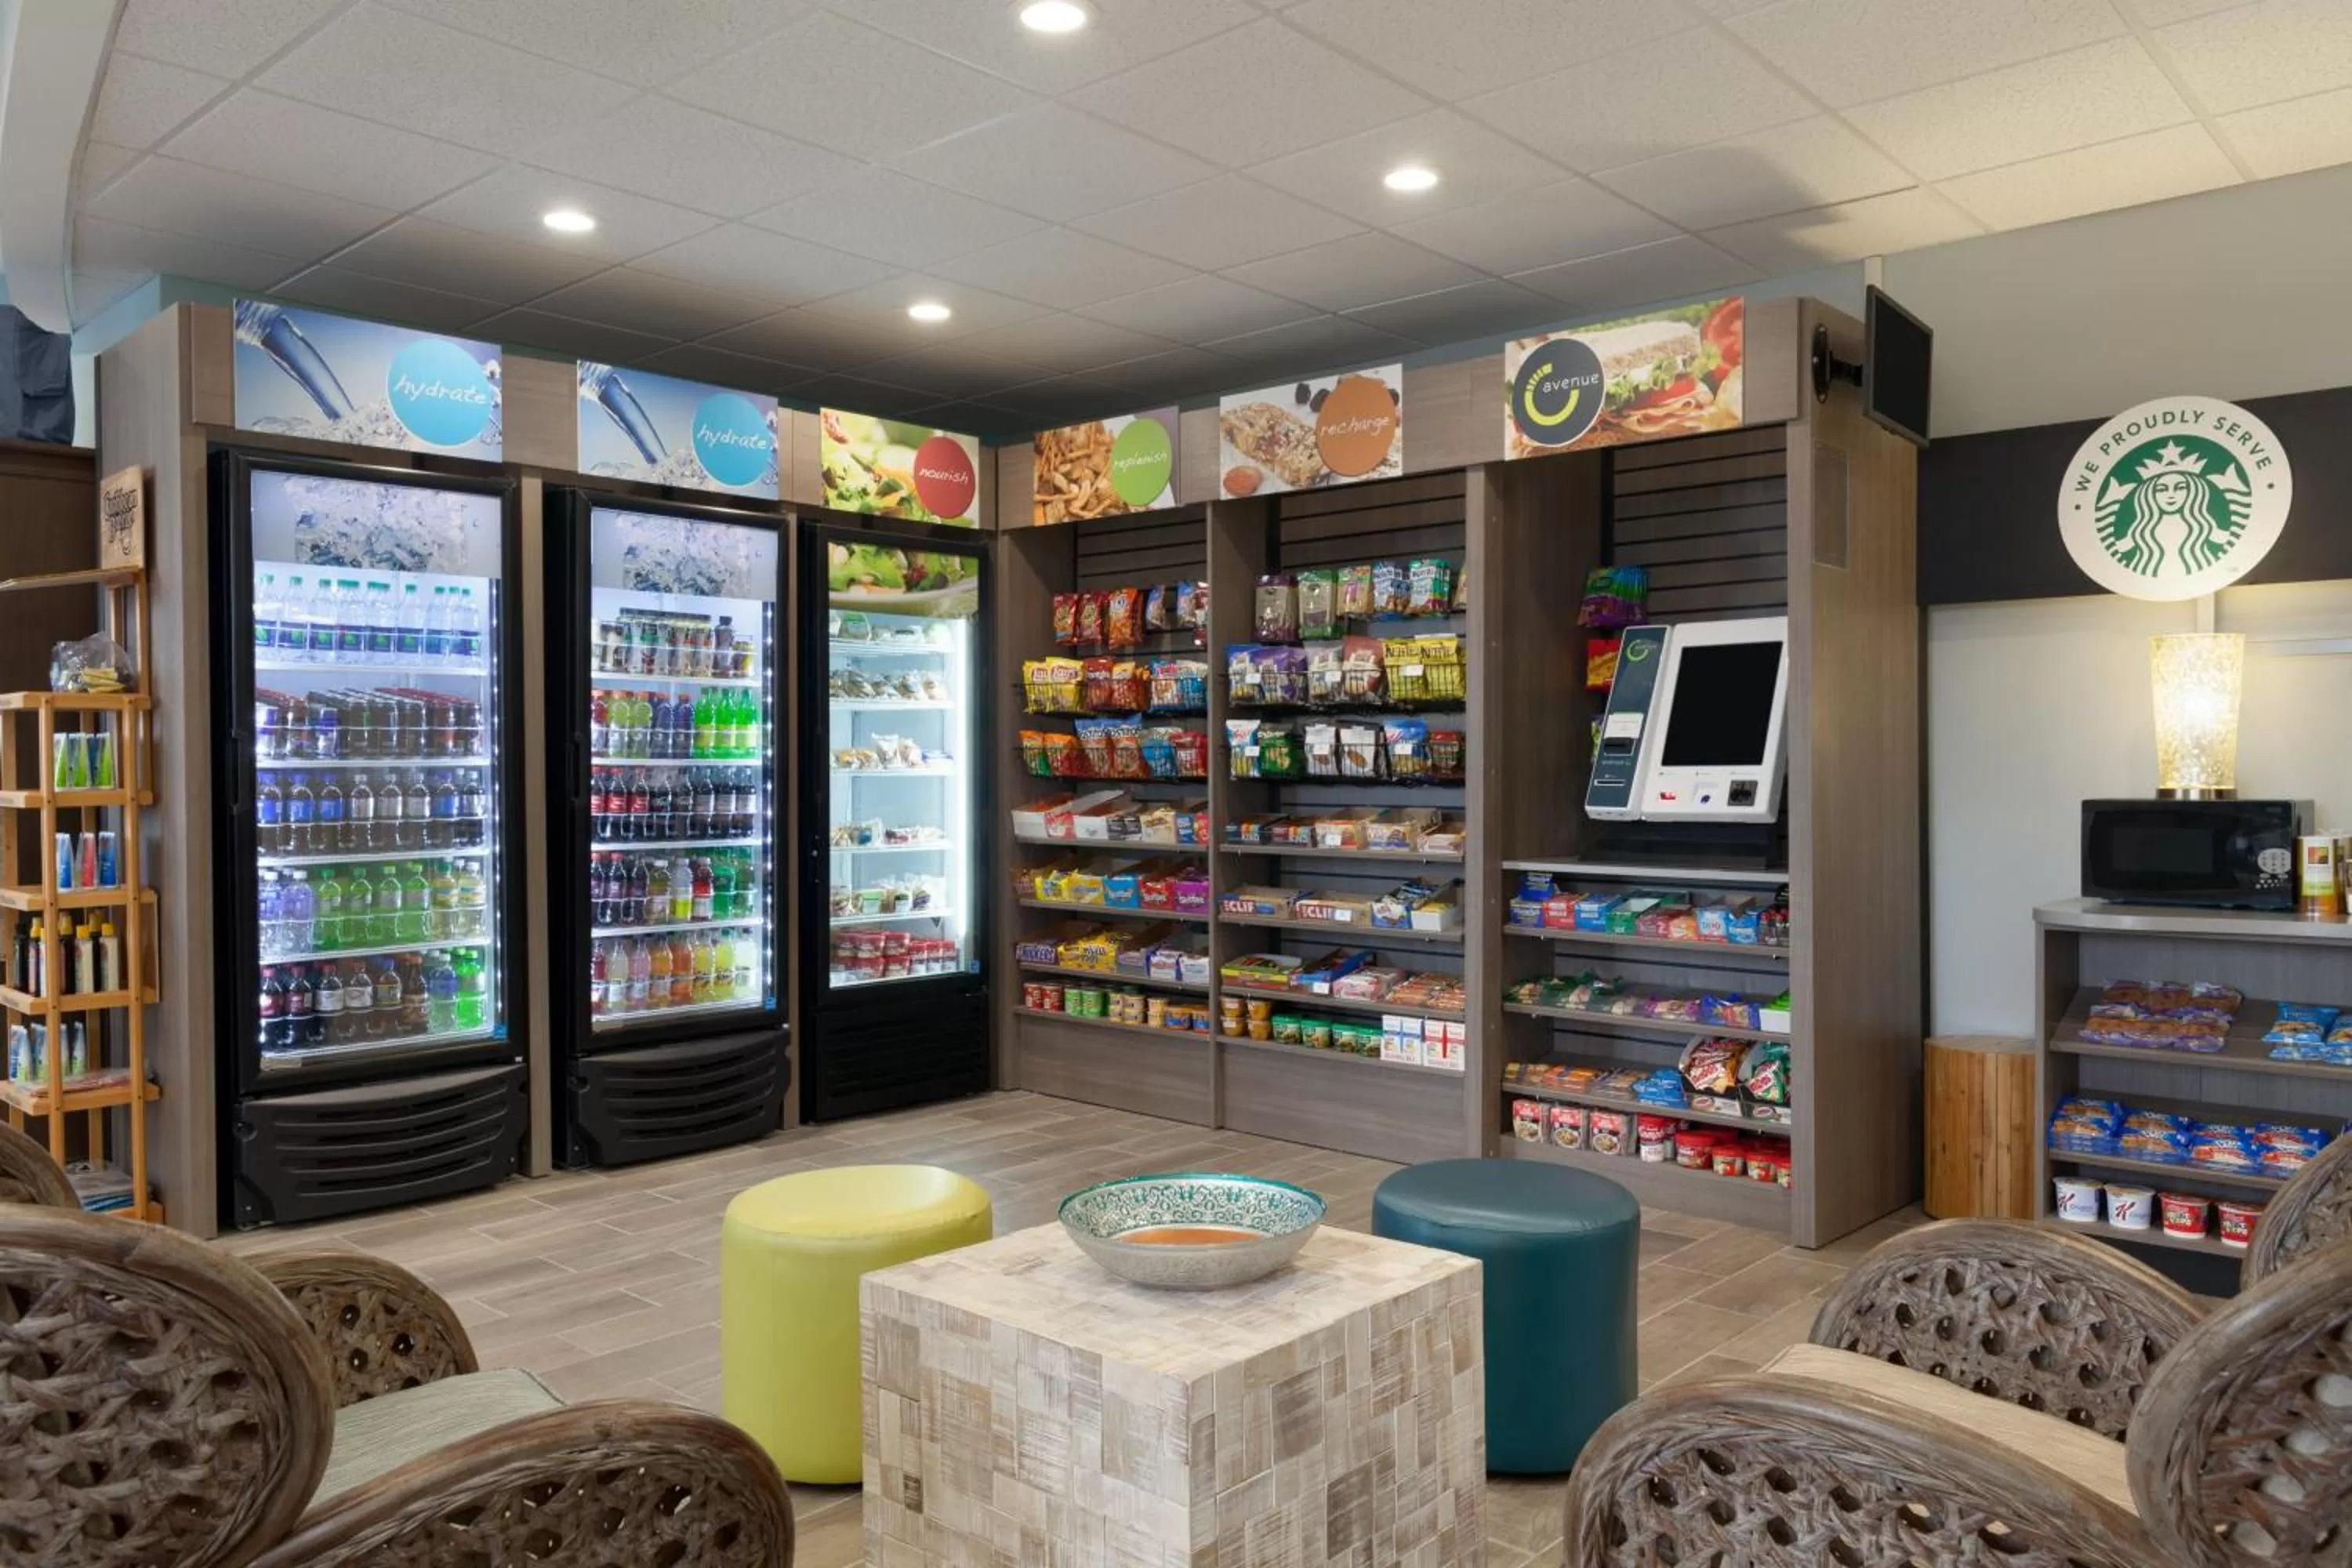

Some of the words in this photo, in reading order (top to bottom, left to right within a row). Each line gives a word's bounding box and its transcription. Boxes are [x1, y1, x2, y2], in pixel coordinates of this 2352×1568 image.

[394, 374, 487, 404] hydrate
[1542, 373, 1599, 393] avenue
[697, 423, 768, 449] hydrate
[1319, 417, 1393, 437] recharge
[1113, 450, 1167, 473] replenish
[2074, 459, 2100, 493] WE
[2099, 409, 2205, 456] PROUDLY
[2212, 416, 2273, 471] SERVE
[918, 468, 970, 485] nourish
[2115, 1201, 2136, 1221] K
